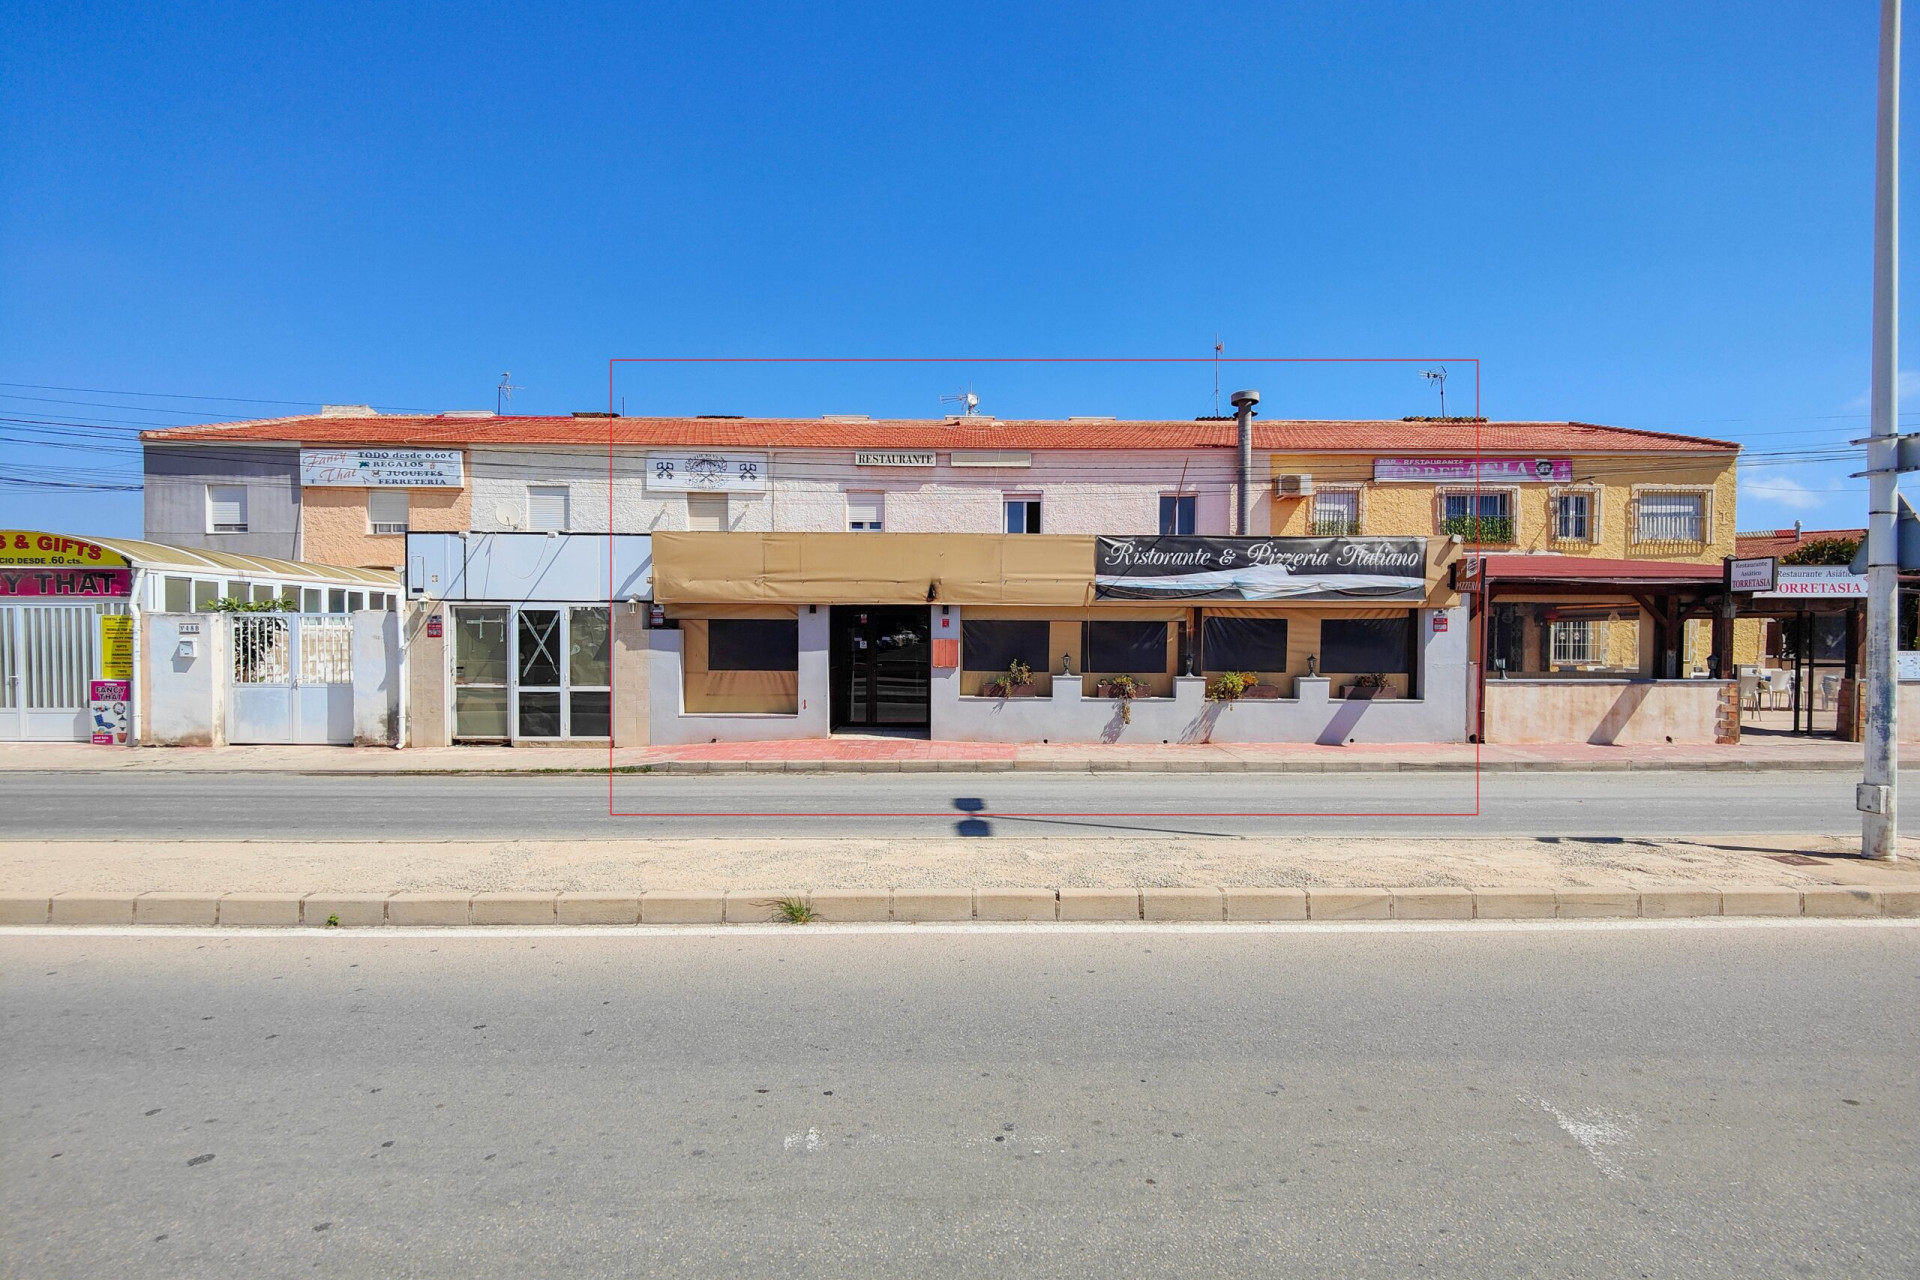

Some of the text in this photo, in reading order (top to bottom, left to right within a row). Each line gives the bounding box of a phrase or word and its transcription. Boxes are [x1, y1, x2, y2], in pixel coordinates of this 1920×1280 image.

[302, 452, 347, 472] Fancy
[859, 454, 934, 464] RESTAURANTE
[319, 468, 357, 483] That
[378, 477, 447, 485] FERRETERÍA
[14, 534, 31, 550] &
[37, 536, 102, 561] GIFTS
[1104, 541, 1419, 572] Ristorante & Pizzeria Italiano
[1735, 560, 1768, 568] Restaurante
[33, 572, 117, 594] THAT
[1456, 581, 1480, 591] PIZZERI
[1732, 578, 1771, 589] TORRETASIA
[95, 686, 127, 694] FANCY
